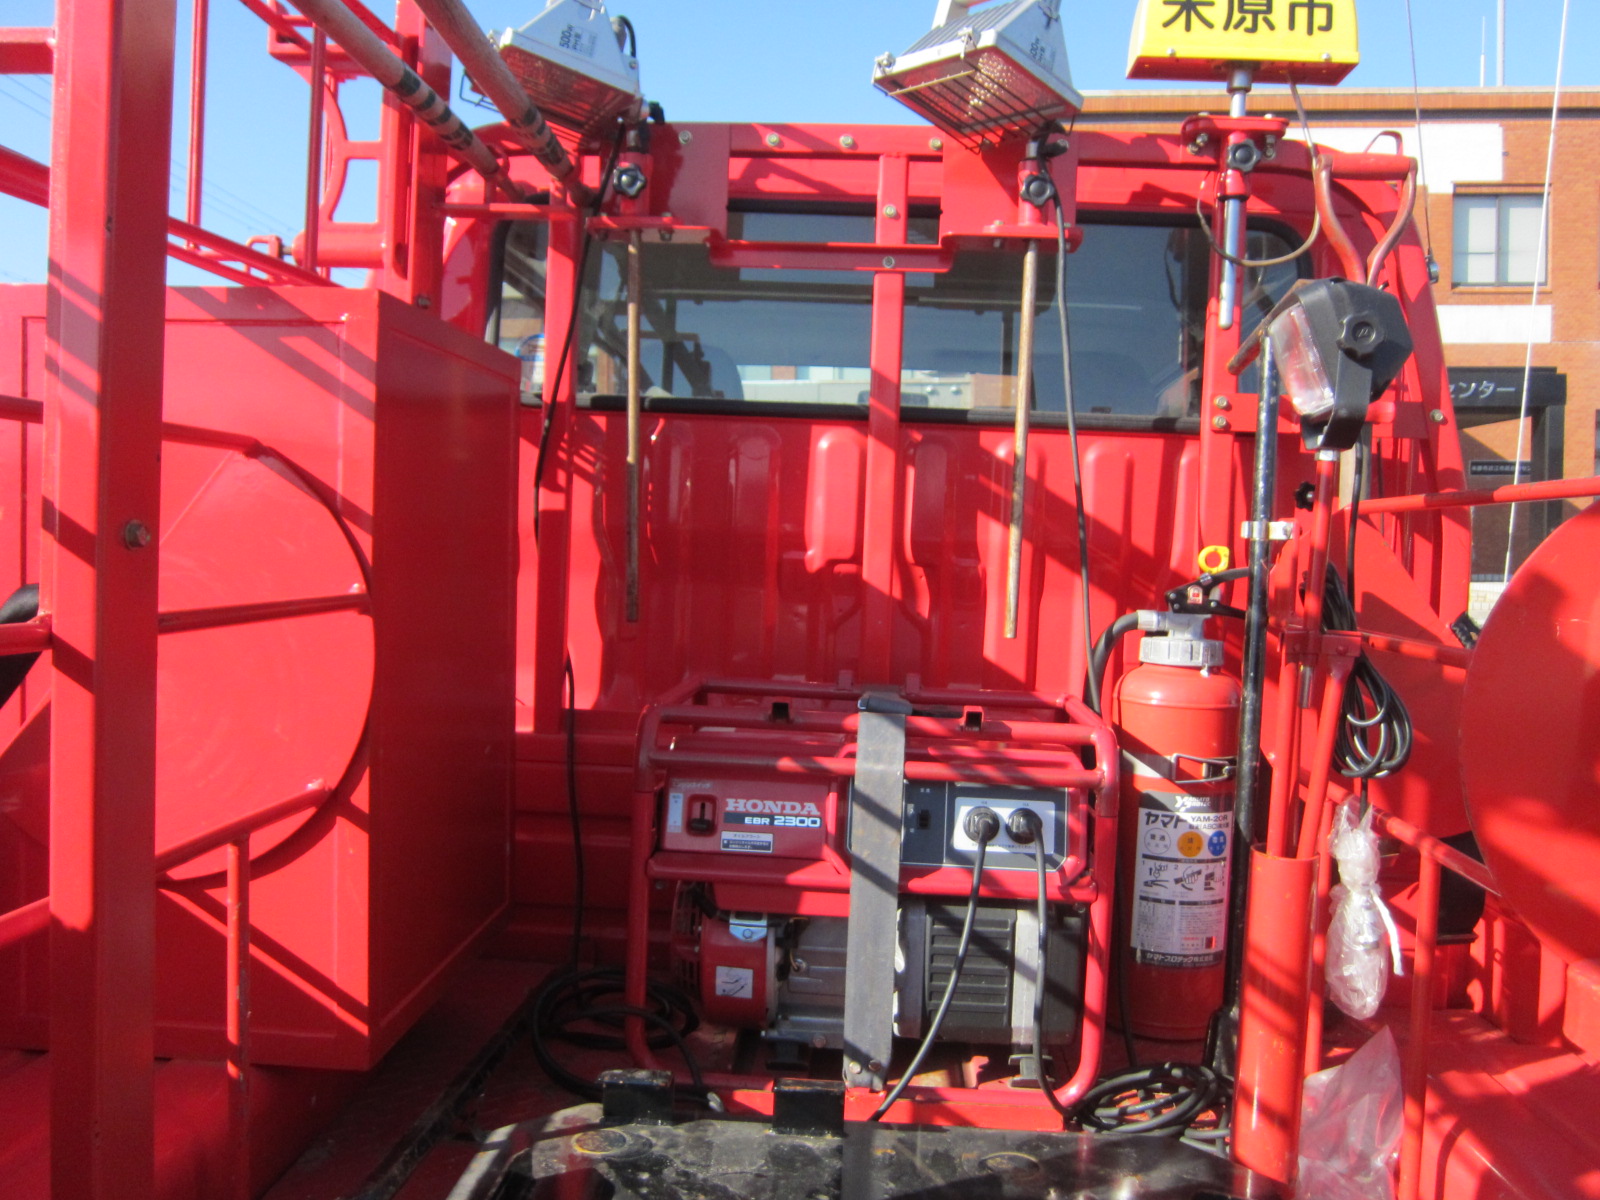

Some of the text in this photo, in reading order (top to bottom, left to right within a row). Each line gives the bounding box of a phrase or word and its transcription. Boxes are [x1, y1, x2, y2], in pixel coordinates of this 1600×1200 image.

[725, 798, 821, 815] HONDA
[744, 815, 821, 828] EBR 2300
[1144, 811, 1188, 829] ヤマト
